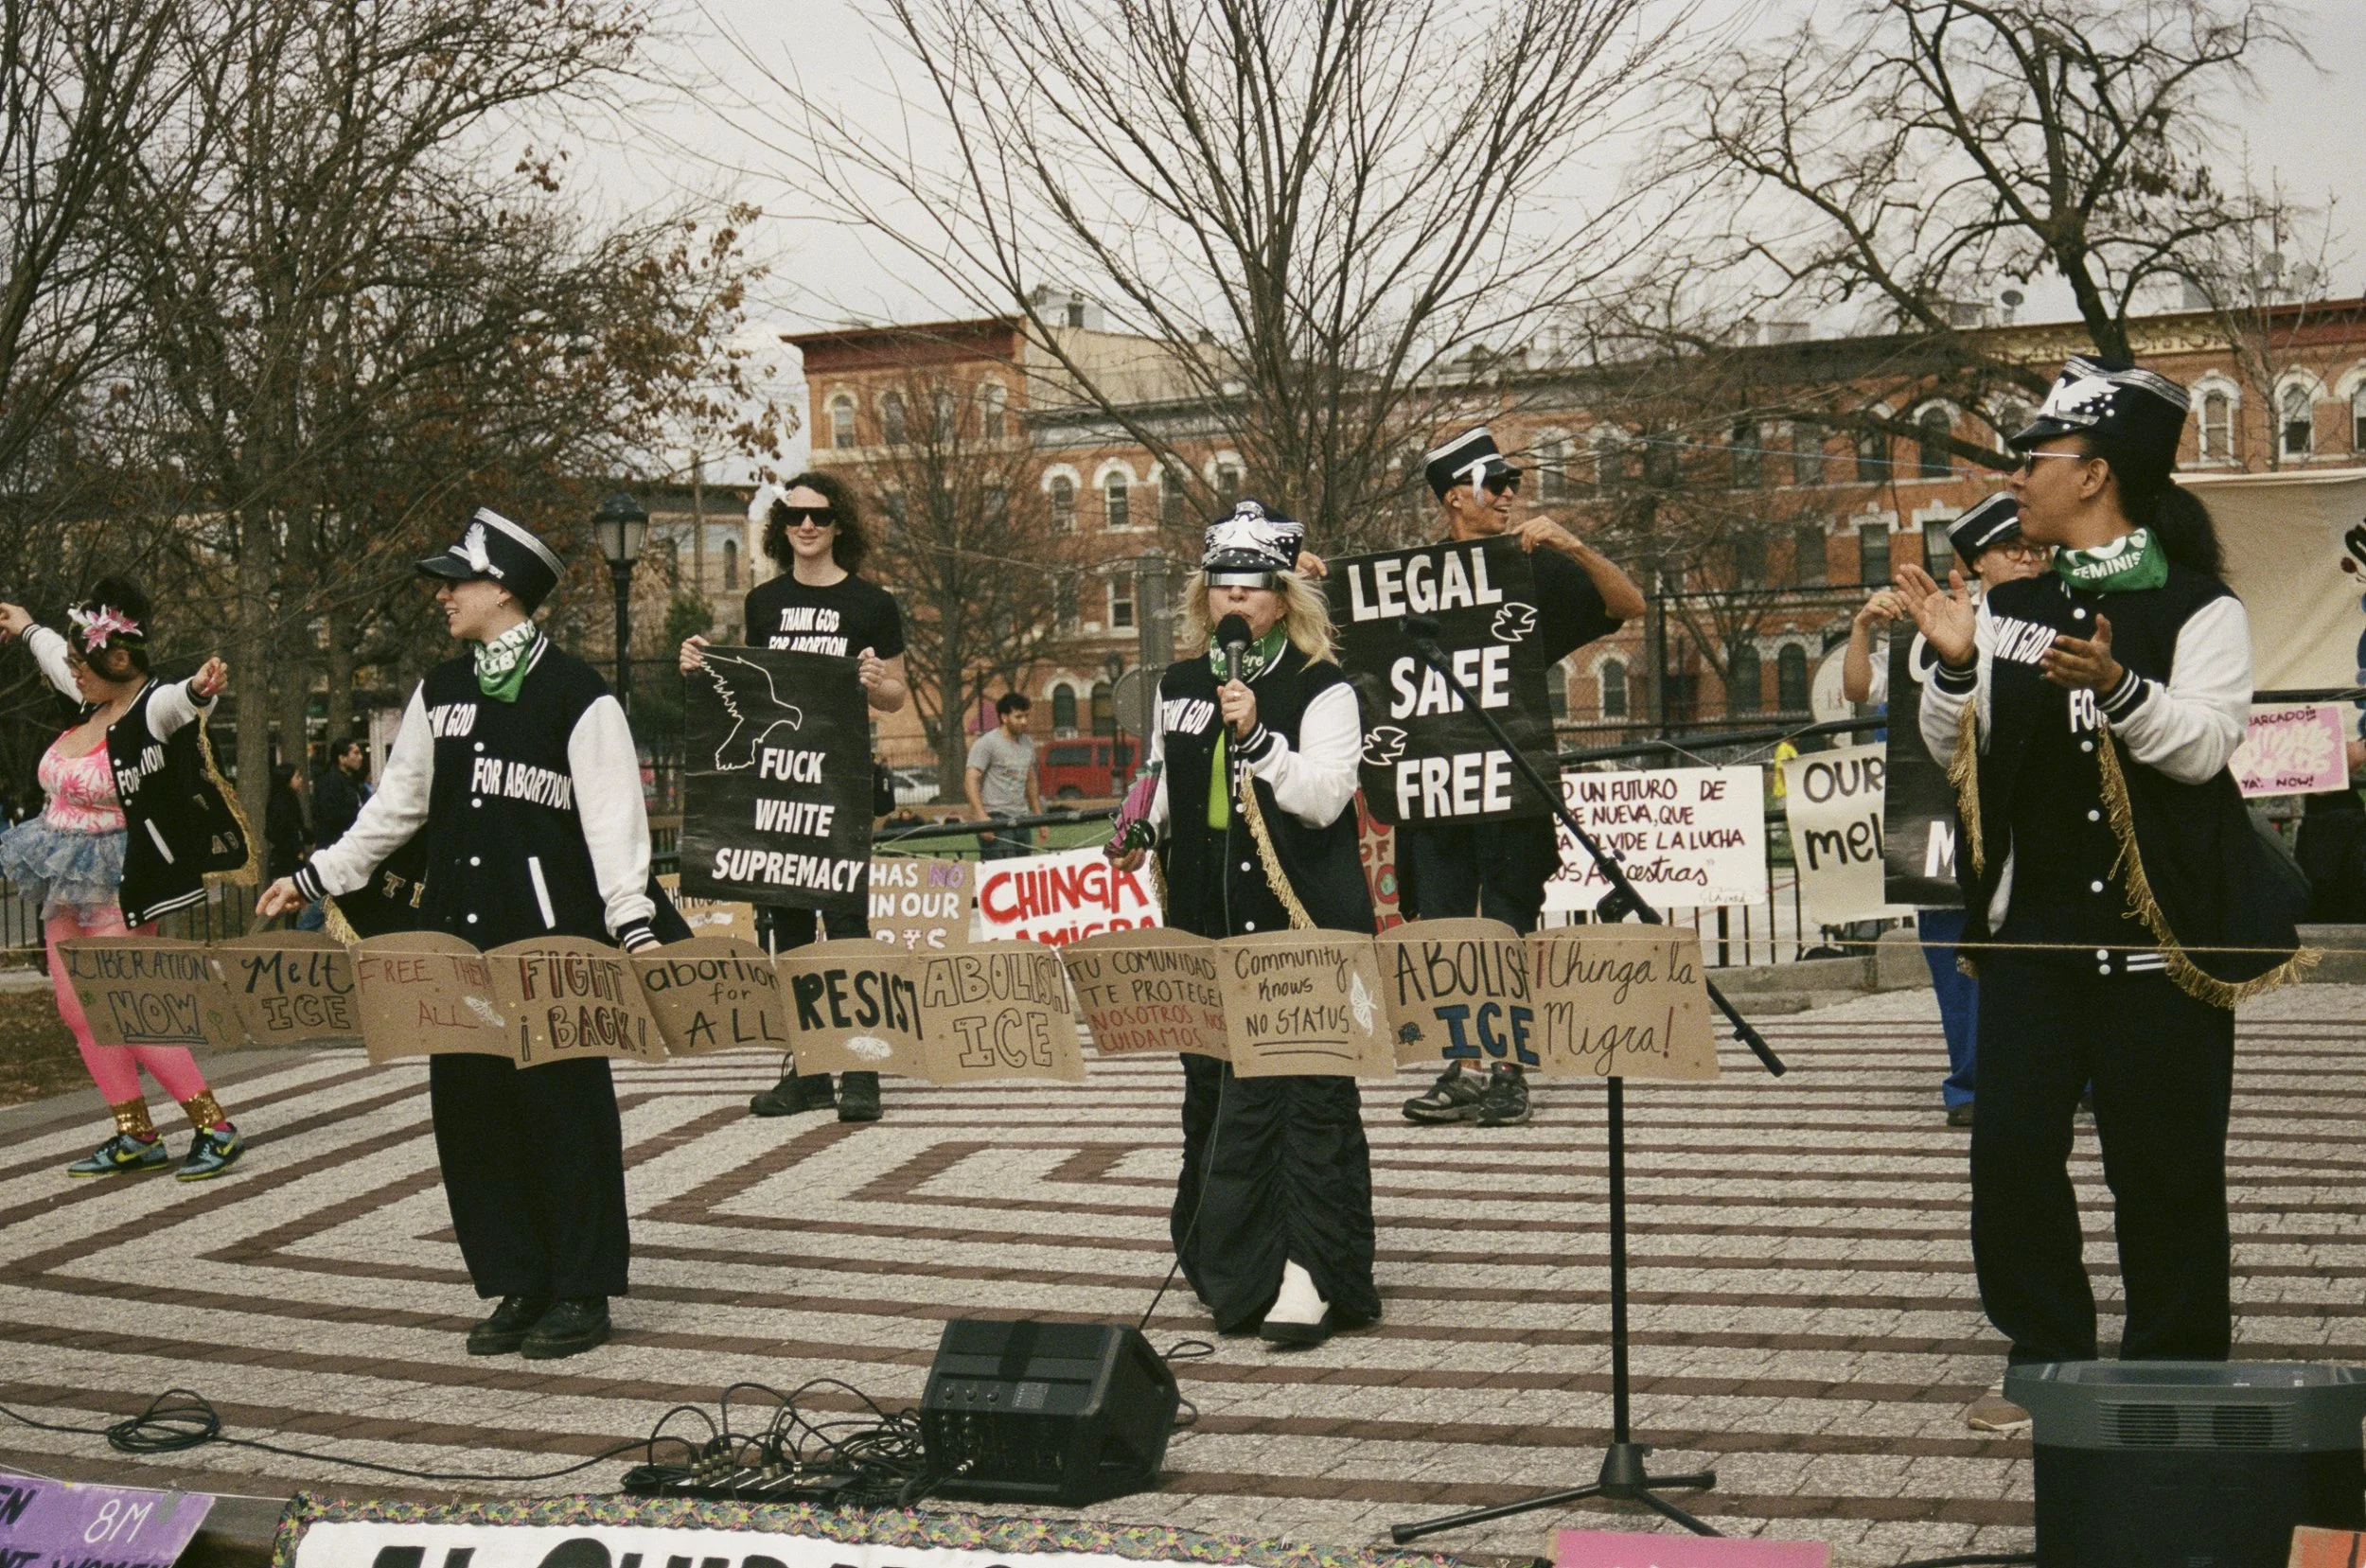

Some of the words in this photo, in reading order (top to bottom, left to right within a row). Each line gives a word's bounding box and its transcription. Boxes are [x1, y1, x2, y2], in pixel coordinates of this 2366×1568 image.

[2072, 550, 2145, 580] FEMINIS
[1348, 547, 1503, 623] LEGAL
[780, 607, 816, 632] THANK
[815, 608, 840, 633] GOD
[2011, 622, 2057, 664] GOD
[1390, 644, 1510, 720] SAFE
[445, 703, 477, 737] GOD
[1179, 698, 1215, 736] GOD
[471, 757, 503, 795] FOR
[503, 762, 572, 810] ABORTION
[760, 747, 825, 784] FUCK
[1396, 749, 1513, 820] FREE
[1803, 756, 1885, 803] OUR
[1580, 782, 1606, 802] UN
[1611, 778, 1678, 802] FUTURO
[1700, 780, 1727, 802] DE
[754, 799, 836, 837] WHITE
[1659, 805, 1695, 825] QUE
[1656, 833, 1685, 850] LA
[1690, 829, 1745, 850] LUCHA
[712, 848, 865, 892] SUPREMACY
[869, 862, 918, 888] HAS
[927, 863, 963, 888] NO
[900, 892, 960, 920] OUR
[68, 948, 210, 982] LIBERATION
[241, 949, 356, 994] Melt
[358, 957, 433, 994] FREE
[519, 949, 625, 1007] FIGHT
[1112, 949, 1216, 980] COMUNIDAD
[1234, 946, 1349, 994] Community
[1669, 937, 1697, 986] la
[709, 982, 751, 1005] for
[923, 952, 1070, 1015] ABOLISH
[1082, 985, 1119, 1005] TE
[107, 990, 203, 1037] NOW
[262, 994, 352, 1031] ICE
[418, 999, 479, 1030] ALL
[792, 969, 924, 1041] RESIST
[1089, 1004, 1193, 1031] NOSOTROS
[1202, 1009, 1227, 1031] NOS
[1245, 1013, 1268, 1037] NO
[1276, 1005, 1351, 1035] STATUS
[685, 1008, 786, 1048] ALL
[953, 1008, 1053, 1068] ICE
[1100, 1028, 1204, 1052] CUIDAMOS
[1434, 1002, 1541, 1066] ICE
[1544, 1001, 1675, 1077] Migra!
[83, 1498, 154, 1544] 8M
